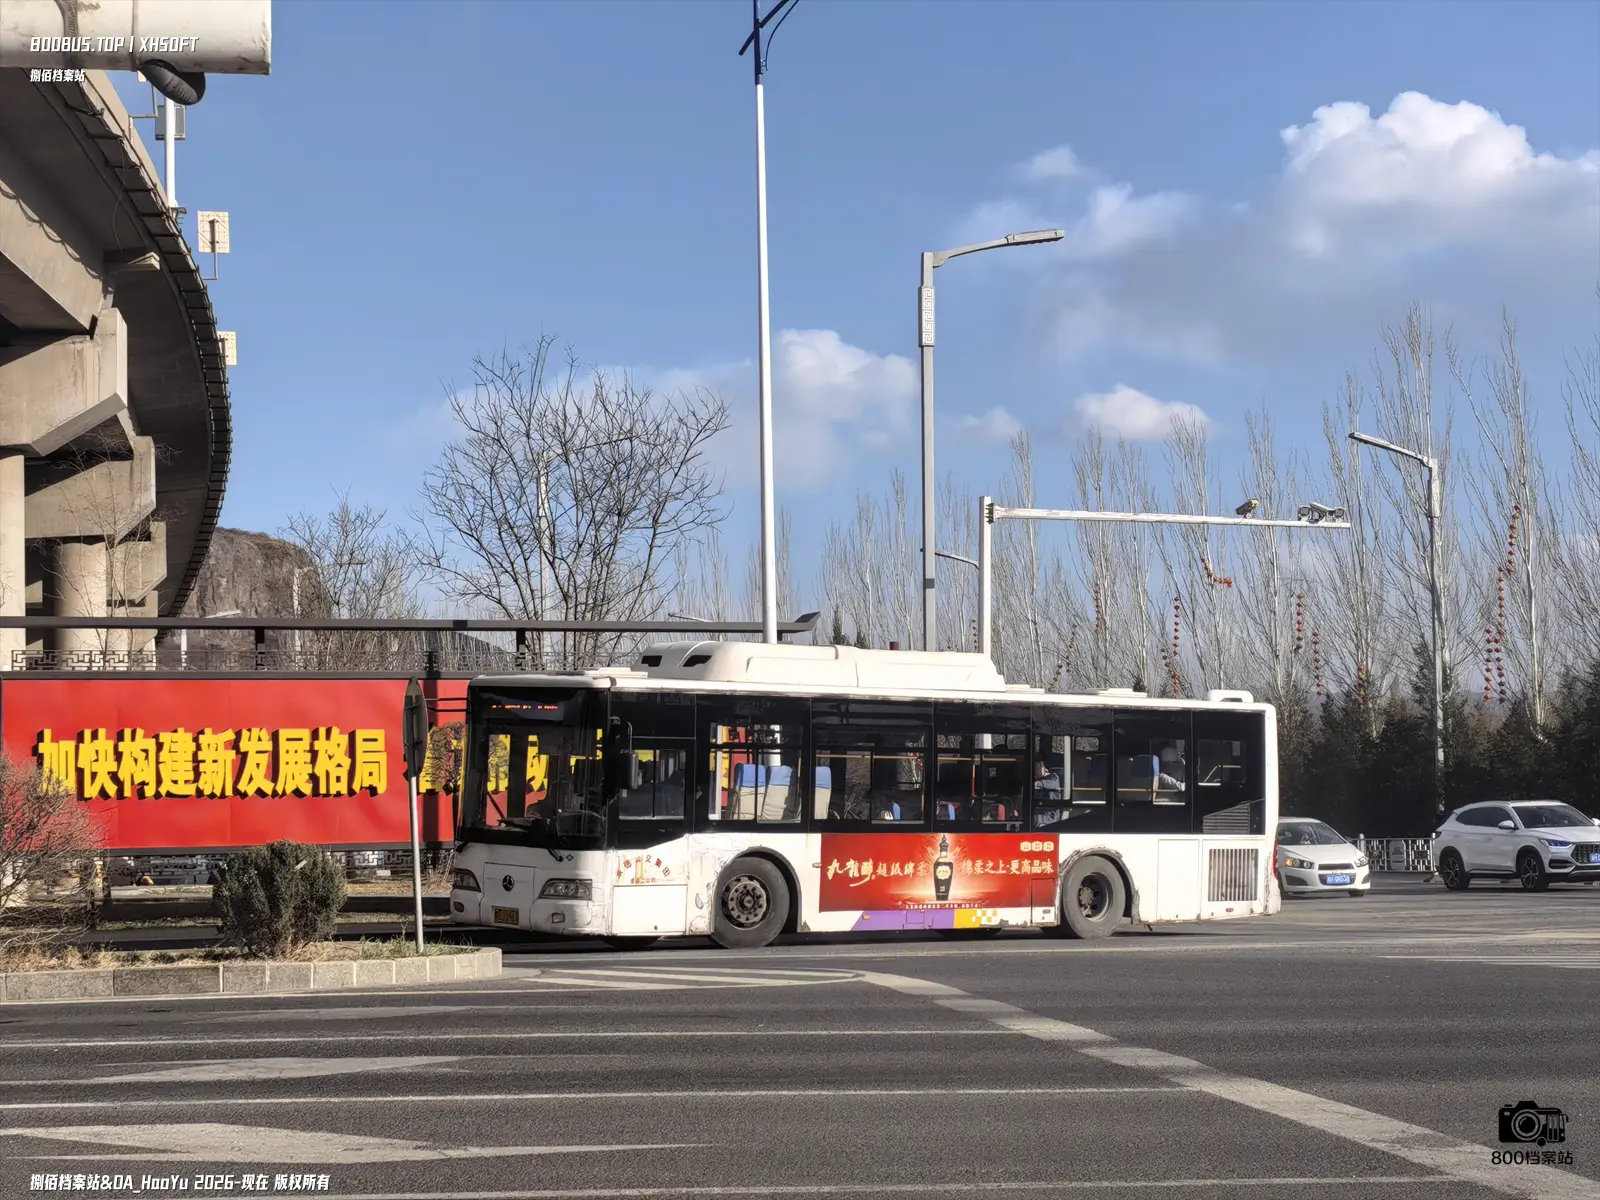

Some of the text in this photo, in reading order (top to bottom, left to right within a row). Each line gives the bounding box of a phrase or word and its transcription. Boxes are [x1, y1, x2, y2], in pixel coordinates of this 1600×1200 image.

[34, 725, 388, 800] 加快构建新发展格局
